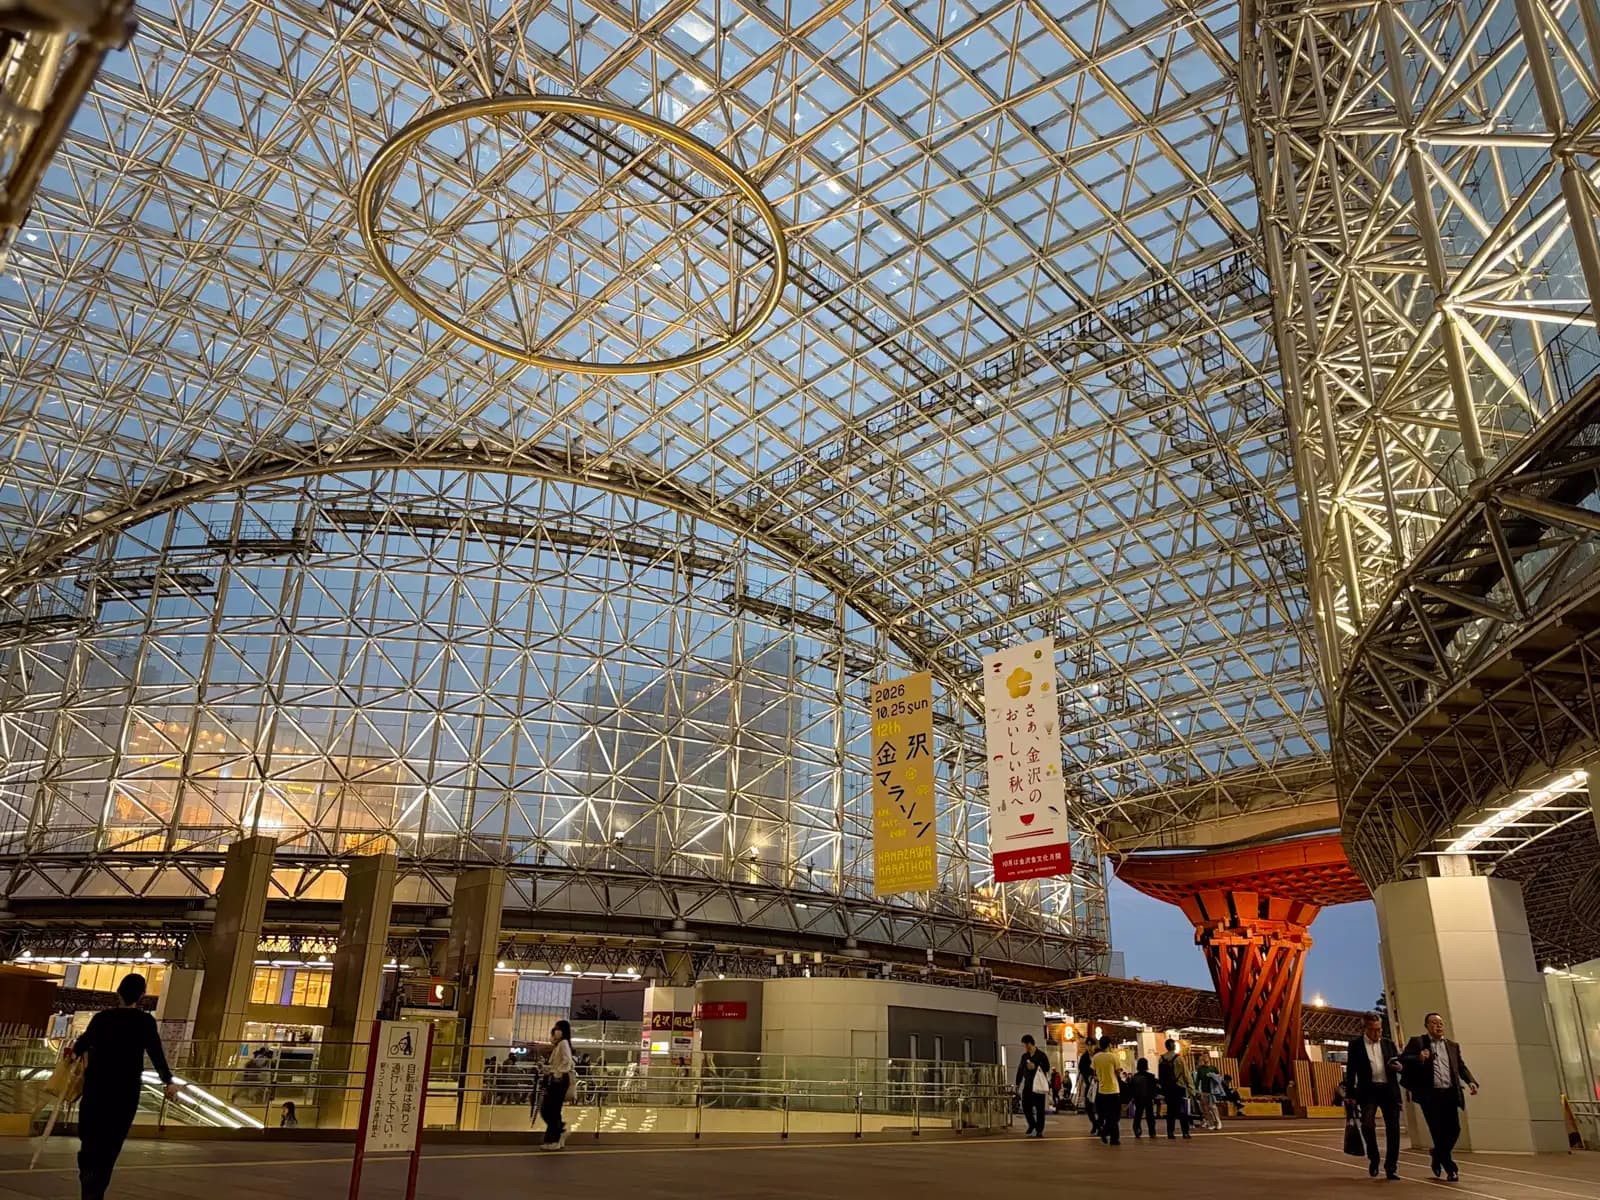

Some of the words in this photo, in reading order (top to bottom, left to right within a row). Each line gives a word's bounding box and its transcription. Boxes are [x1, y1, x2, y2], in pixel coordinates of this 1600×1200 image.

[875, 684, 905, 703] 2026
[876, 721, 901, 737] 12th
[1006, 708, 1024, 805] おいしい秋へ
[1025, 703, 1042, 803] さあ、金沢の
[879, 859, 932, 877] MARATHON
